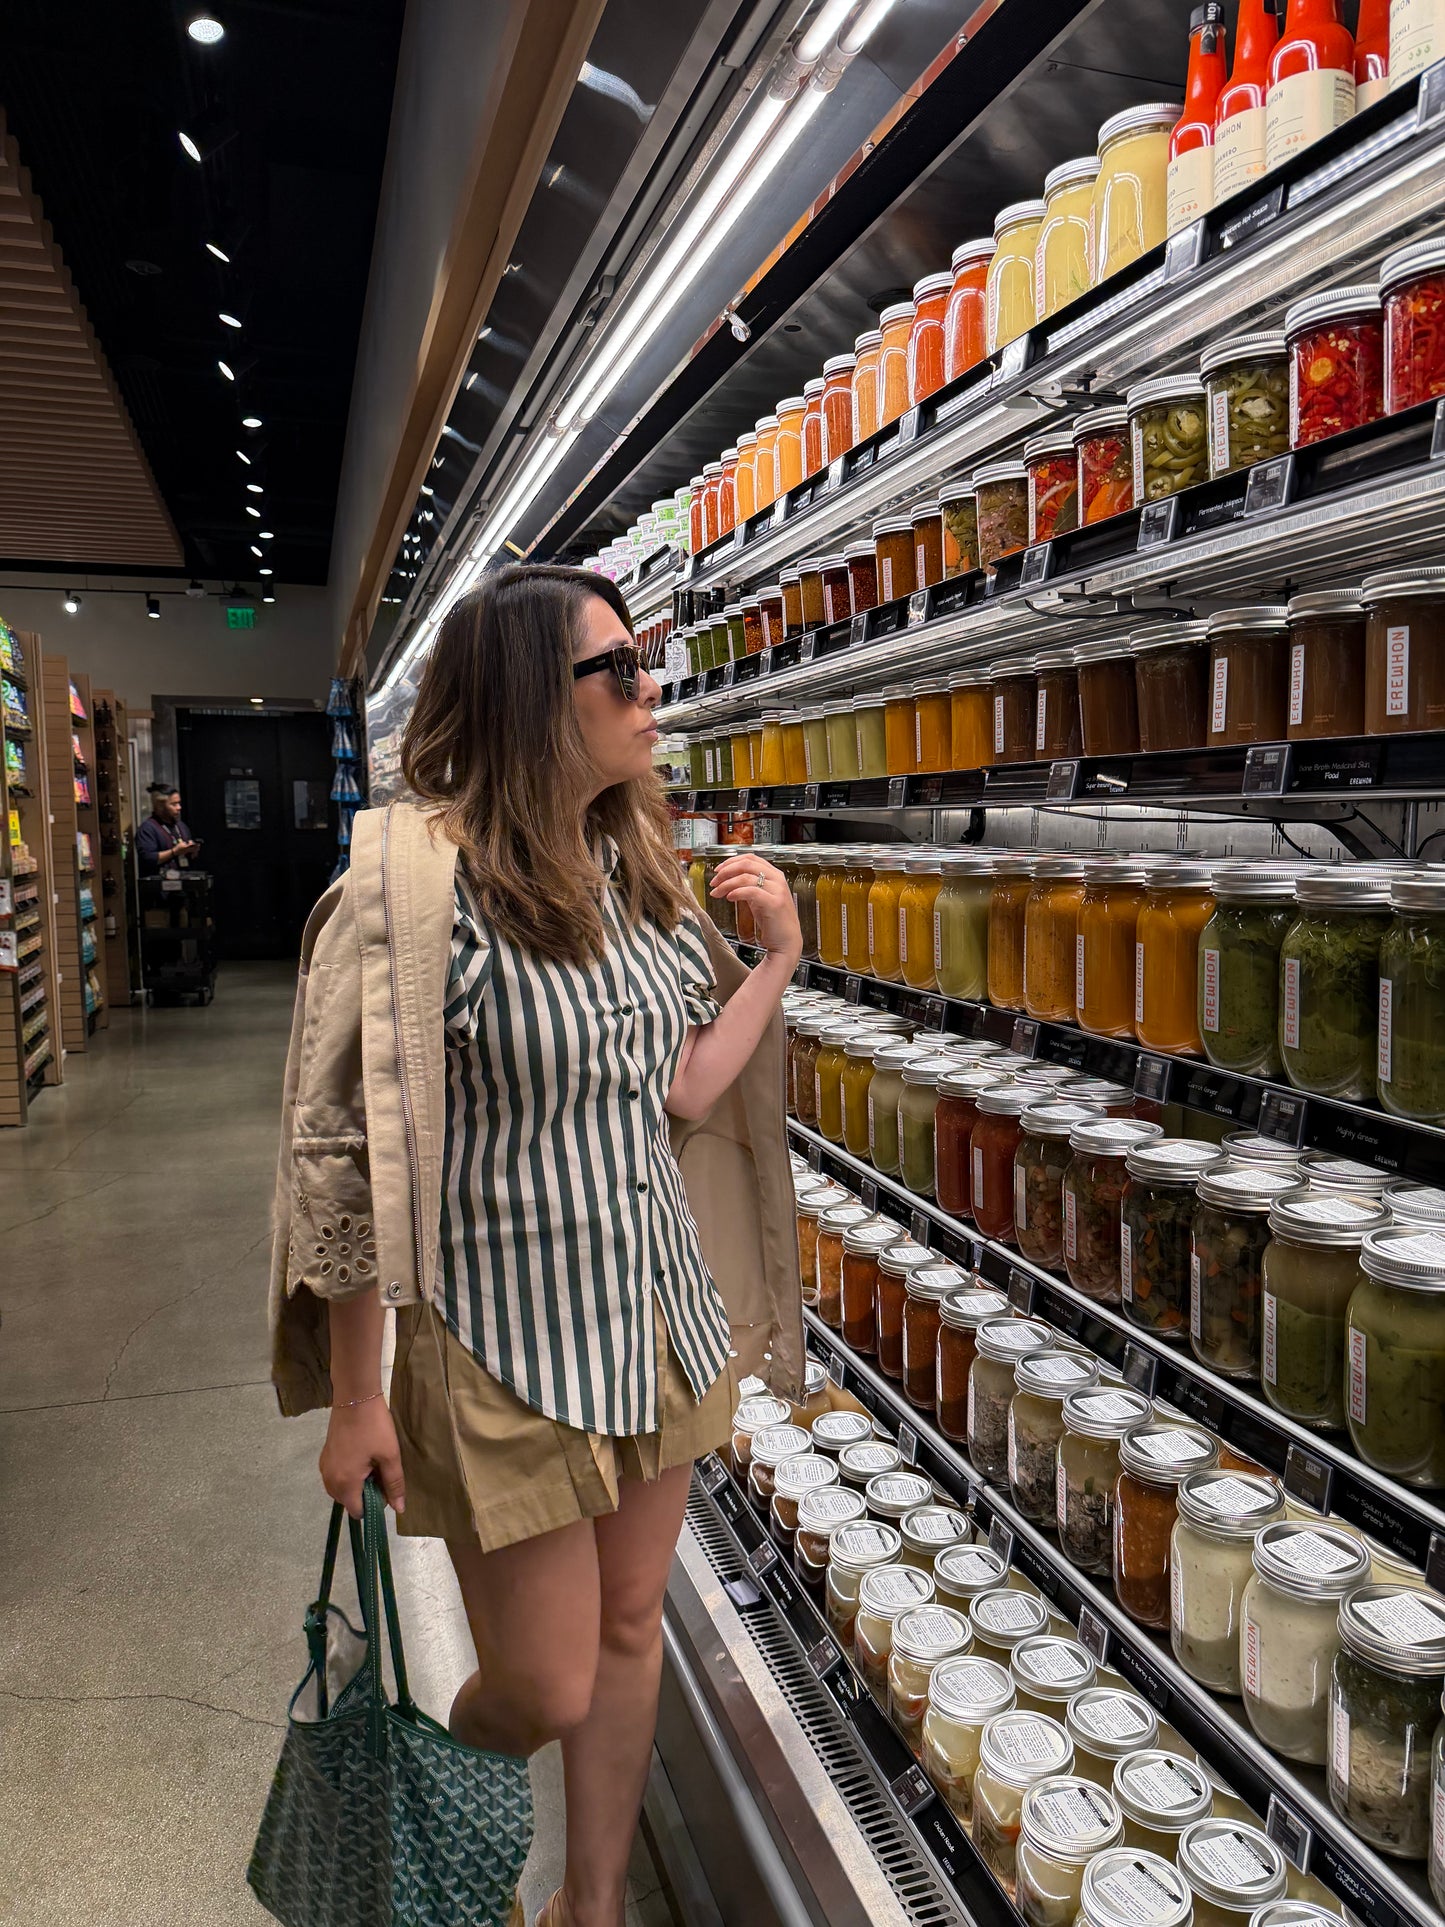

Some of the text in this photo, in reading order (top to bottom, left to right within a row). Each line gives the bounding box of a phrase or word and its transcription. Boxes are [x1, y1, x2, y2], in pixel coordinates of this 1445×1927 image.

[1217, 395, 1225, 467] EREWHON
[1215, 661, 1224, 729] EREWHON
[1291, 649, 1301, 721] EREWHON
[1391, 630, 1404, 711] EREWHON
[1324, 771, 1340, 780] Food
[1206, 951, 1216, 1028] EREWHON
[1286, 962, 1295, 1045] EREWHON
[1380, 984, 1389, 1077] EREWHON
[1336, 1126, 1379, 1145] Mighty Greens
[1375, 1154, 1398, 1168] EREWHON
[1265, 1298, 1274, 1380] EREWHON
[1352, 1333, 1362, 1418] EREWHON
[1361, 1499, 1382, 1517] Sodium
[1362, 1510, 1384, 1528] Greens
[1245, 1624, 1256, 1697] EREWHON
[1325, 1851, 1375, 1906] New England Clam
[1336, 1872, 1361, 1898] Chowder
